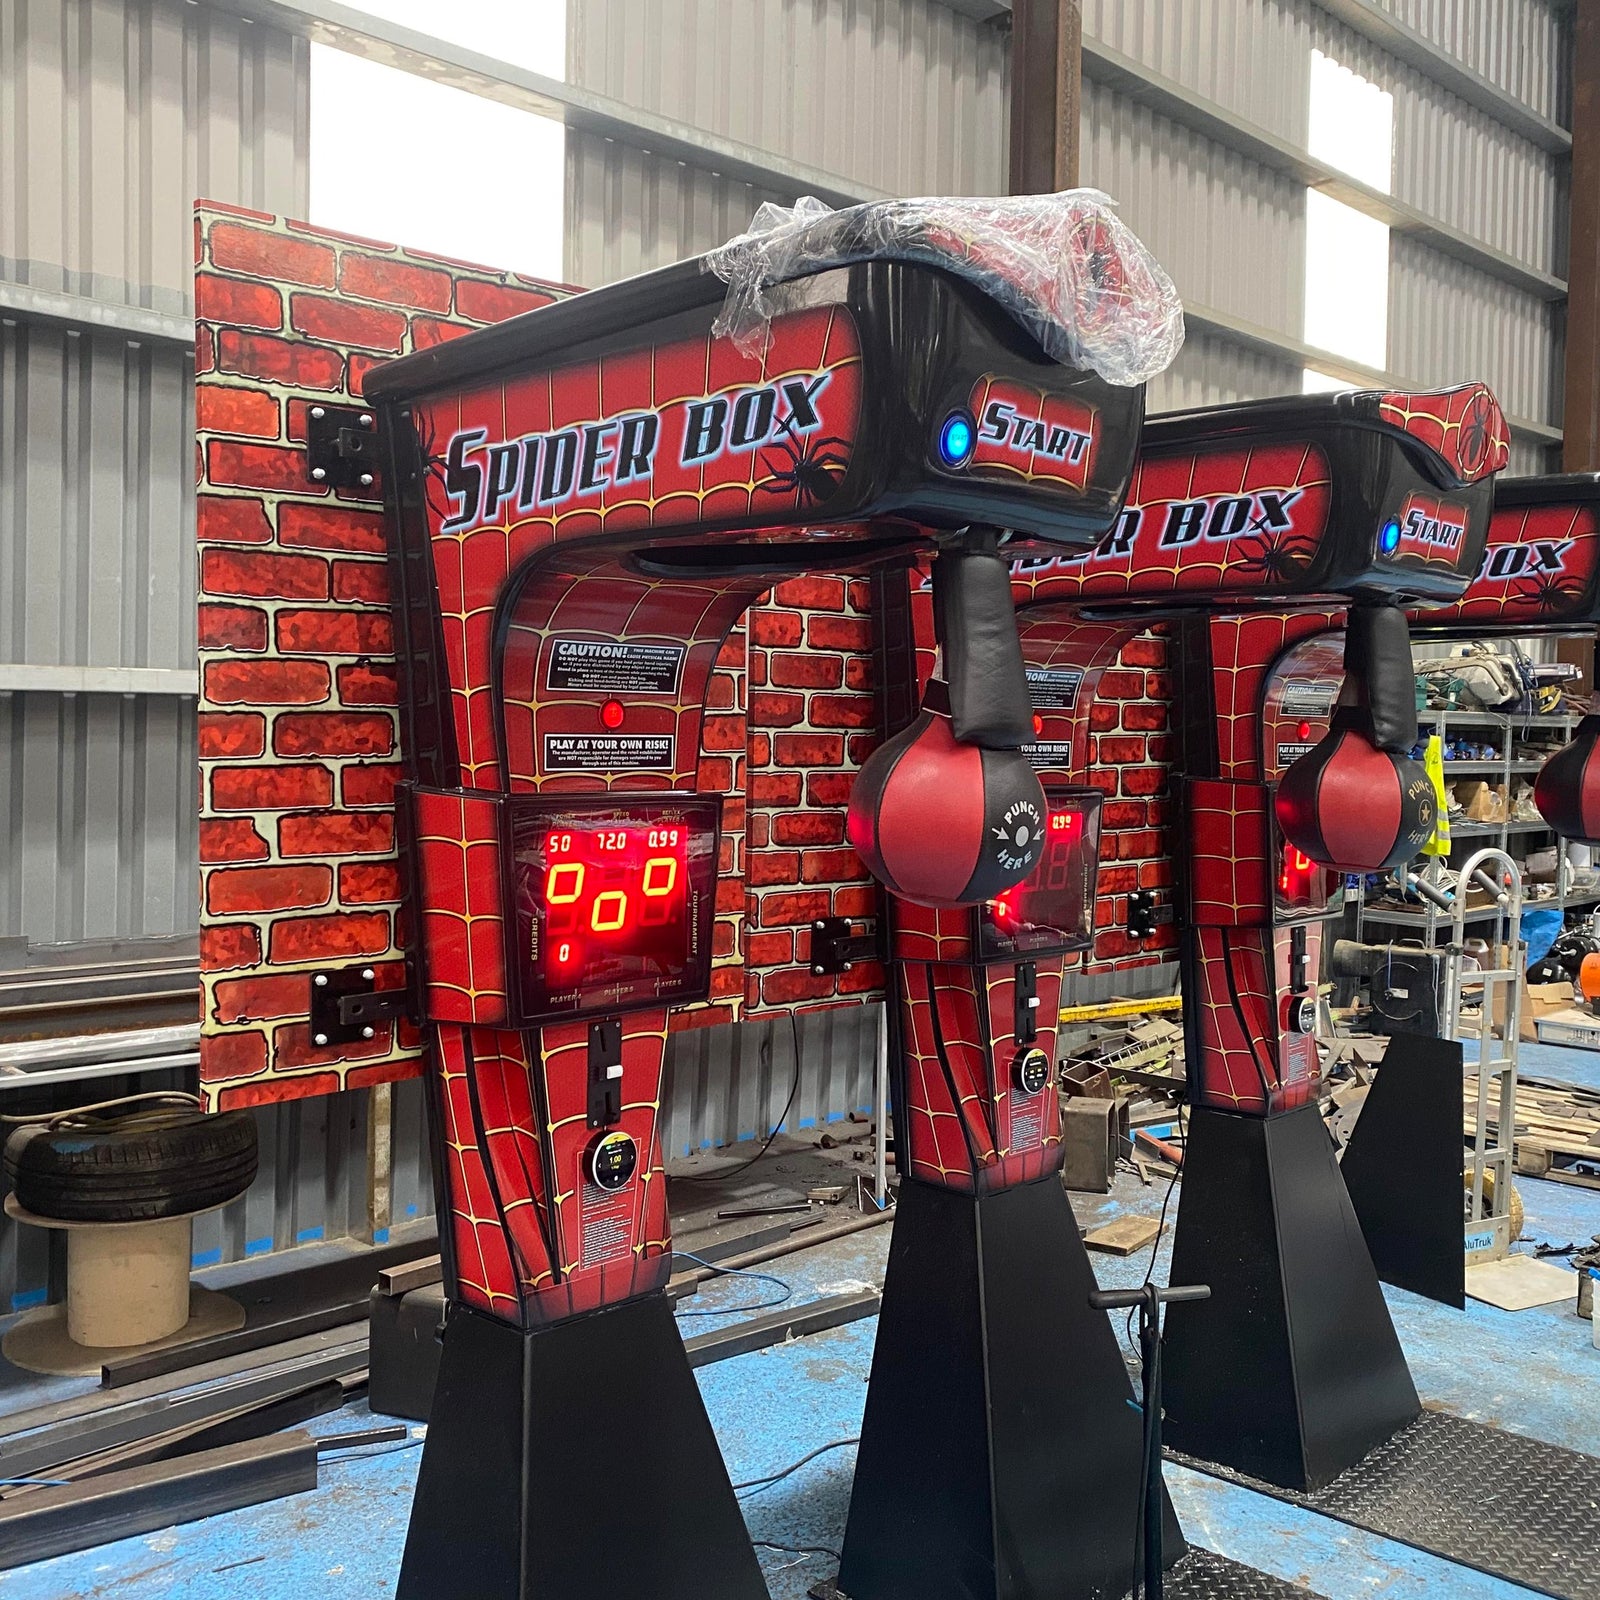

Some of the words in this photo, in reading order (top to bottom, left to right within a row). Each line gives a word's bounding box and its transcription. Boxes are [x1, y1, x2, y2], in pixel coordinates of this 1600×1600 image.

[978, 401, 1092, 463] START
[440, 412, 660, 533] SPIDER
[679, 374, 832, 466] BOX
[1160, 491, 1301, 550] BOX
[1402, 508, 1465, 548] START
[558, 643, 629, 659] CAUTION!
[550, 740, 575, 750] PLAY
[576, 740, 589, 750] AT
[591, 740, 618, 750] YOUR
[620, 740, 642, 750] OWN
[645, 740, 669, 750] RISK!
[1020, 744, 1036, 752] YOUR
[1038, 744, 1052, 752] OWN
[1004, 801, 1040, 825] PUNCH
[549, 834, 572, 853] 50
[997, 849, 1032, 870] HERE
[546, 862, 585, 905] 0
[642, 857, 678, 897] 0
[591, 890, 628, 932] 0
[531, 917, 539, 962] CREDITS
[559, 944, 570, 962] 0
[604, 987, 629, 996] PLAYER
[654, 980, 676, 988] PLAYER
[550, 994, 576, 1004] PLAYER
